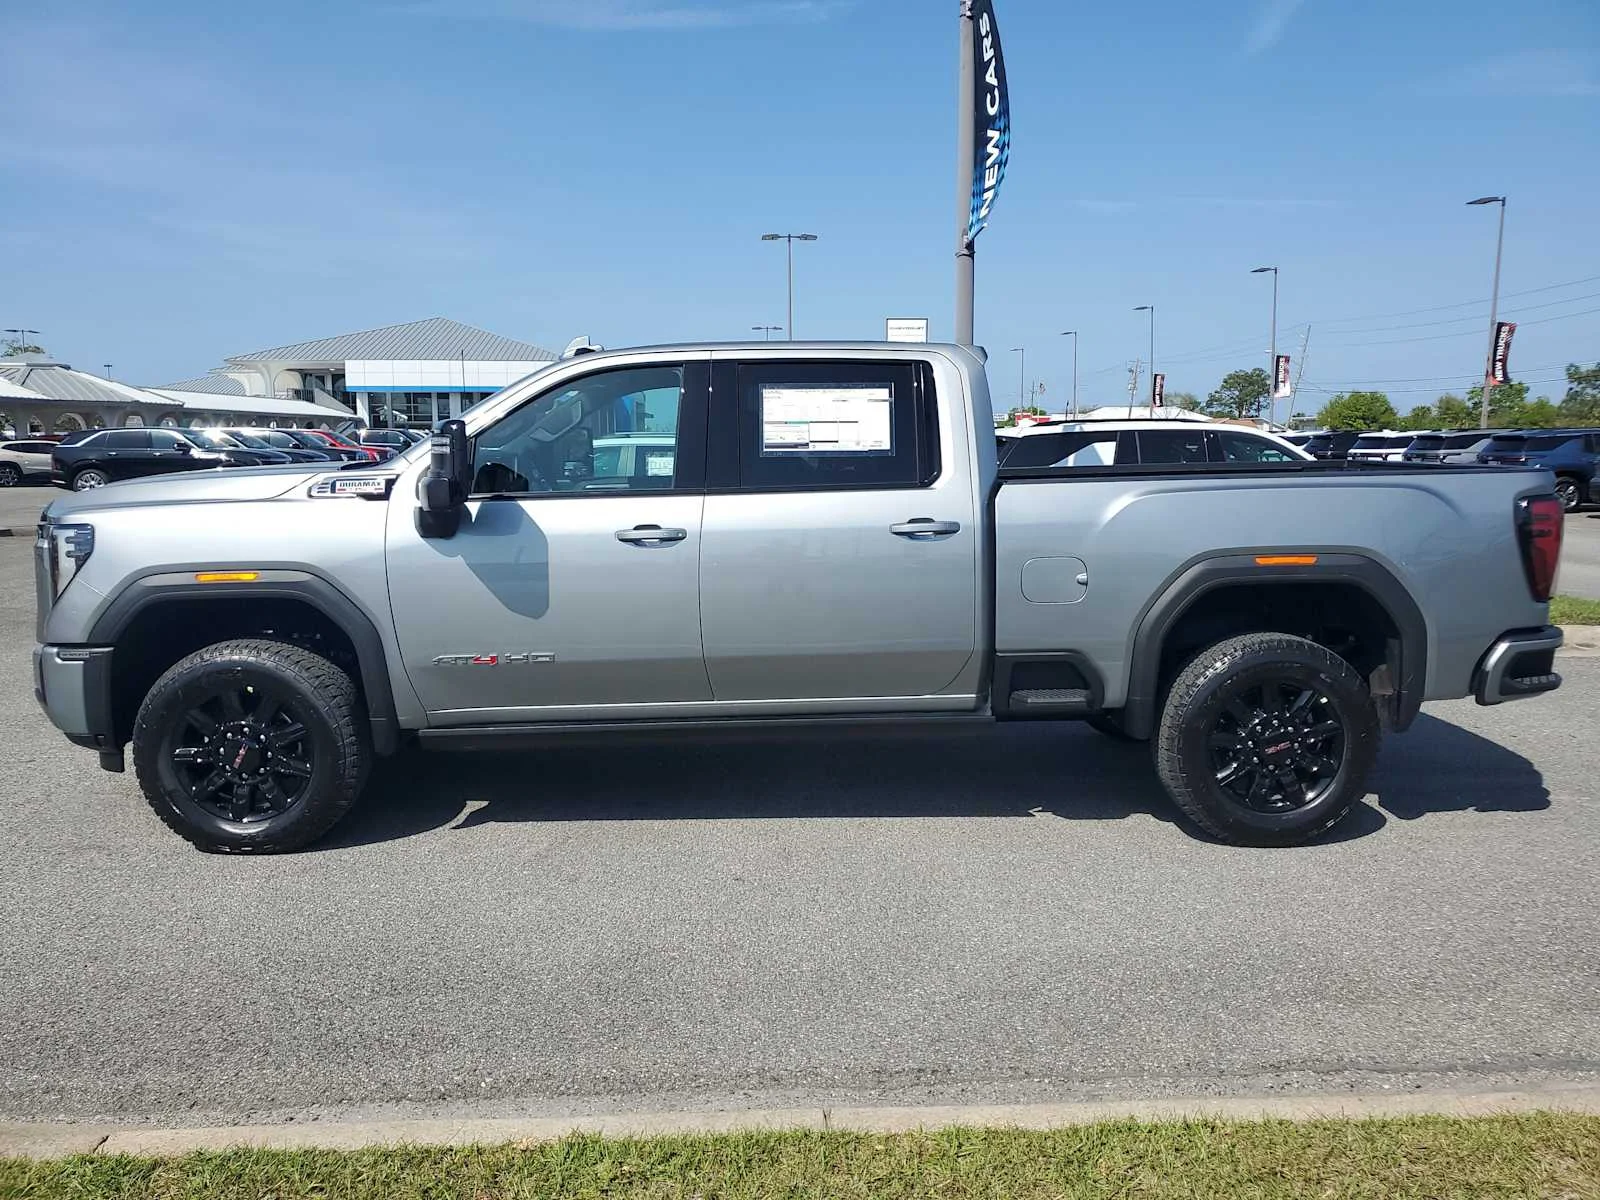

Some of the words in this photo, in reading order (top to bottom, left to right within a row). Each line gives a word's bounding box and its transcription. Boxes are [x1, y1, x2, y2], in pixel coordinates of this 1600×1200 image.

[979, 11, 1000, 116] CARS
[979, 129, 1000, 219] NEW
[1496, 326, 1510, 360] TRUCKS
[1495, 361, 1504, 381] NEW
[432, 654, 498, 666] AT4
[504, 652, 555, 664] HD
